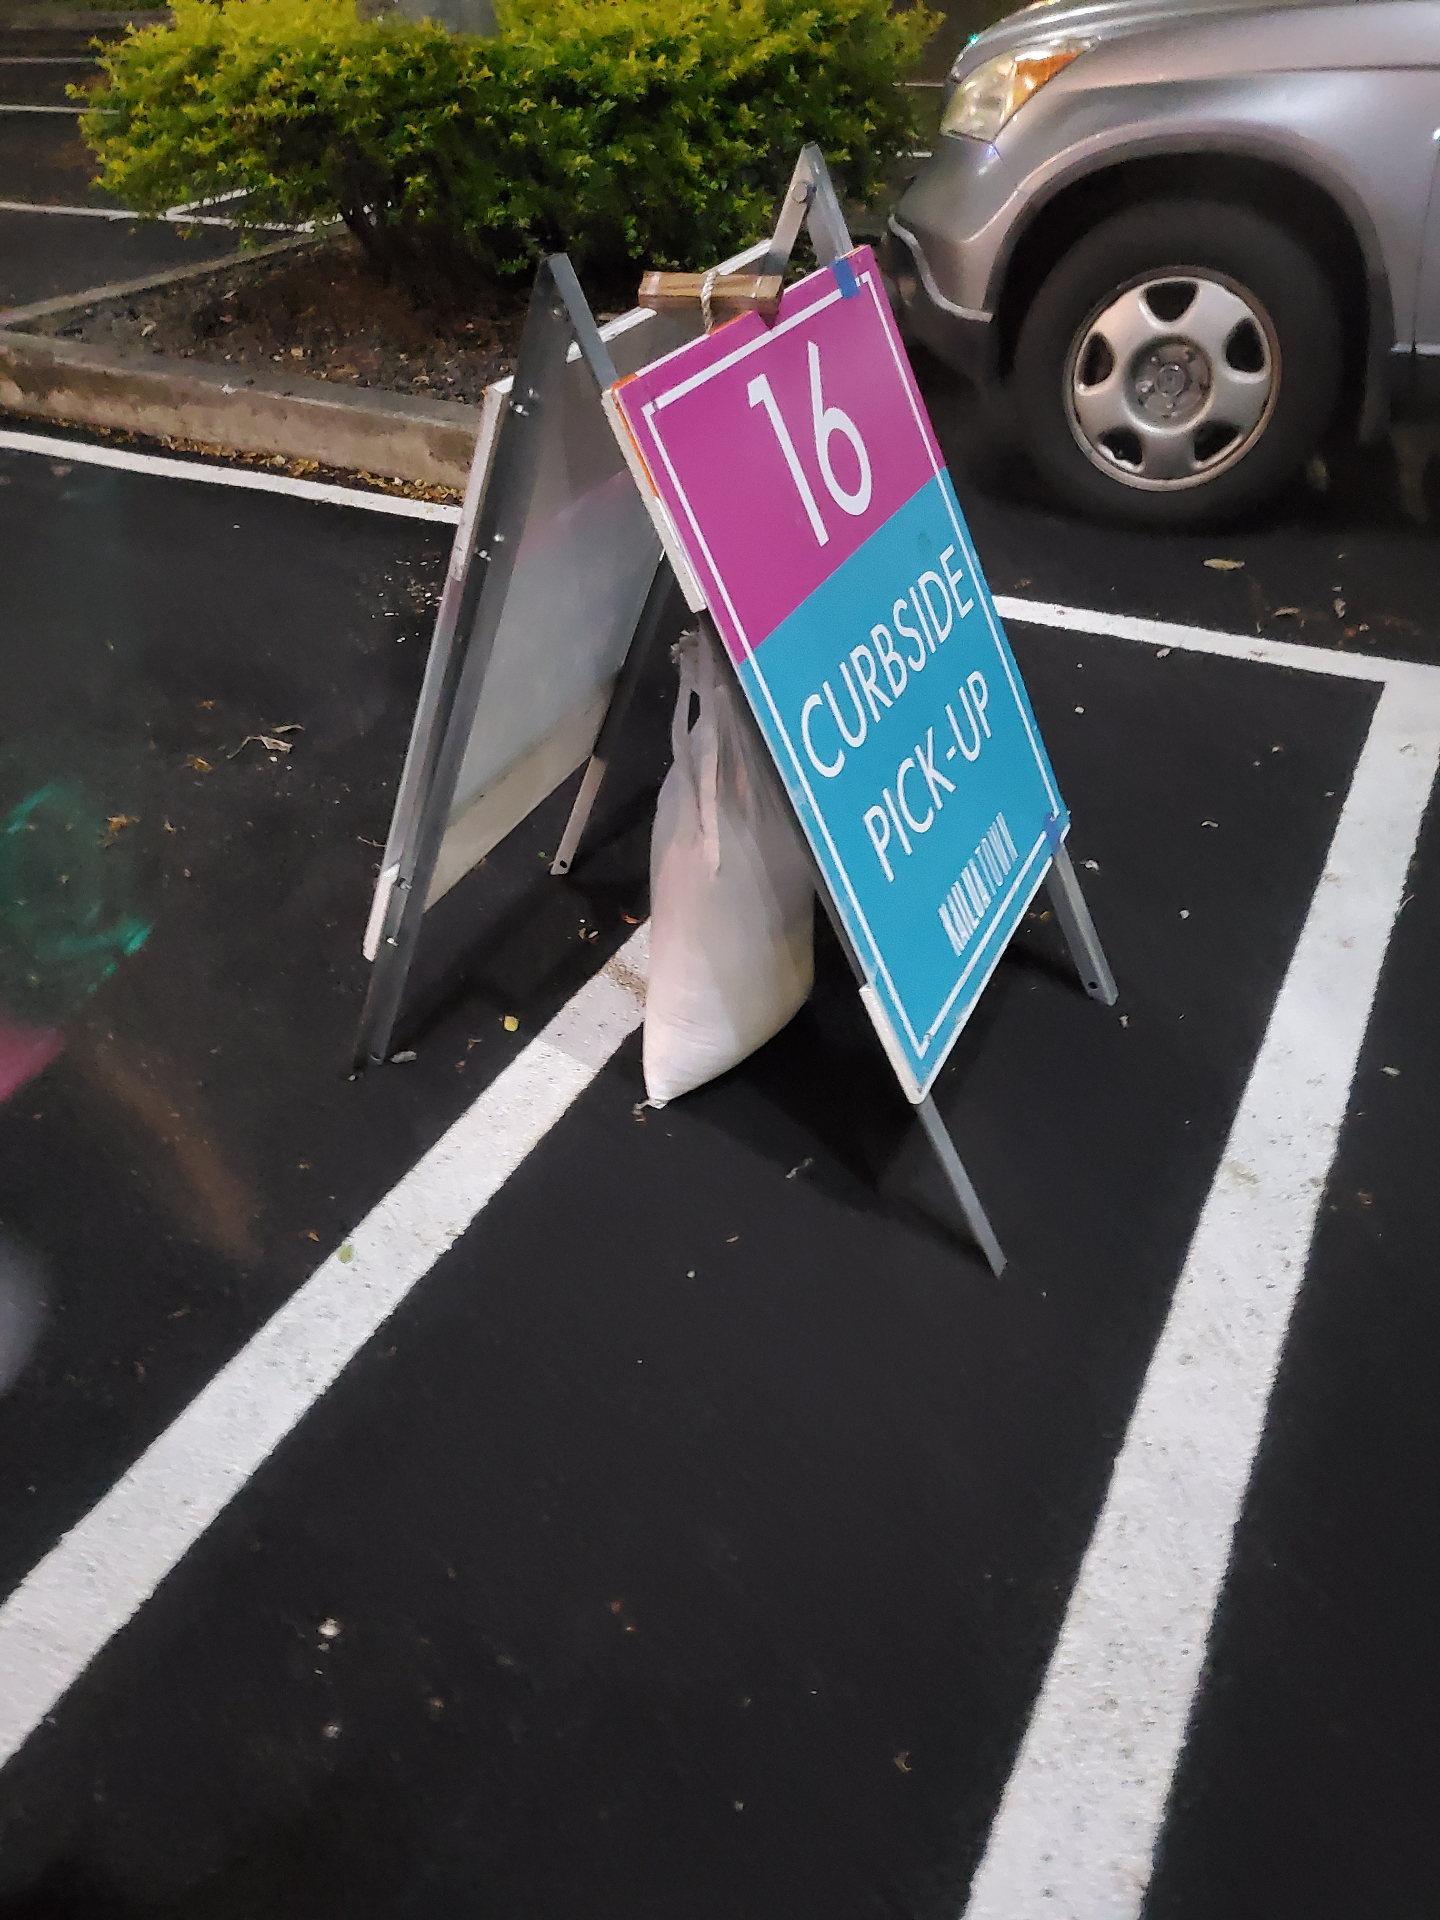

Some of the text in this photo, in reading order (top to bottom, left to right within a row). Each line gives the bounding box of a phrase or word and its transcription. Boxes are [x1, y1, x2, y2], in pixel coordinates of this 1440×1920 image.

[746, 340, 873, 547] 16
[800, 544, 974, 778] CURBSIDE
[863, 670, 992, 883] PICK-UP
